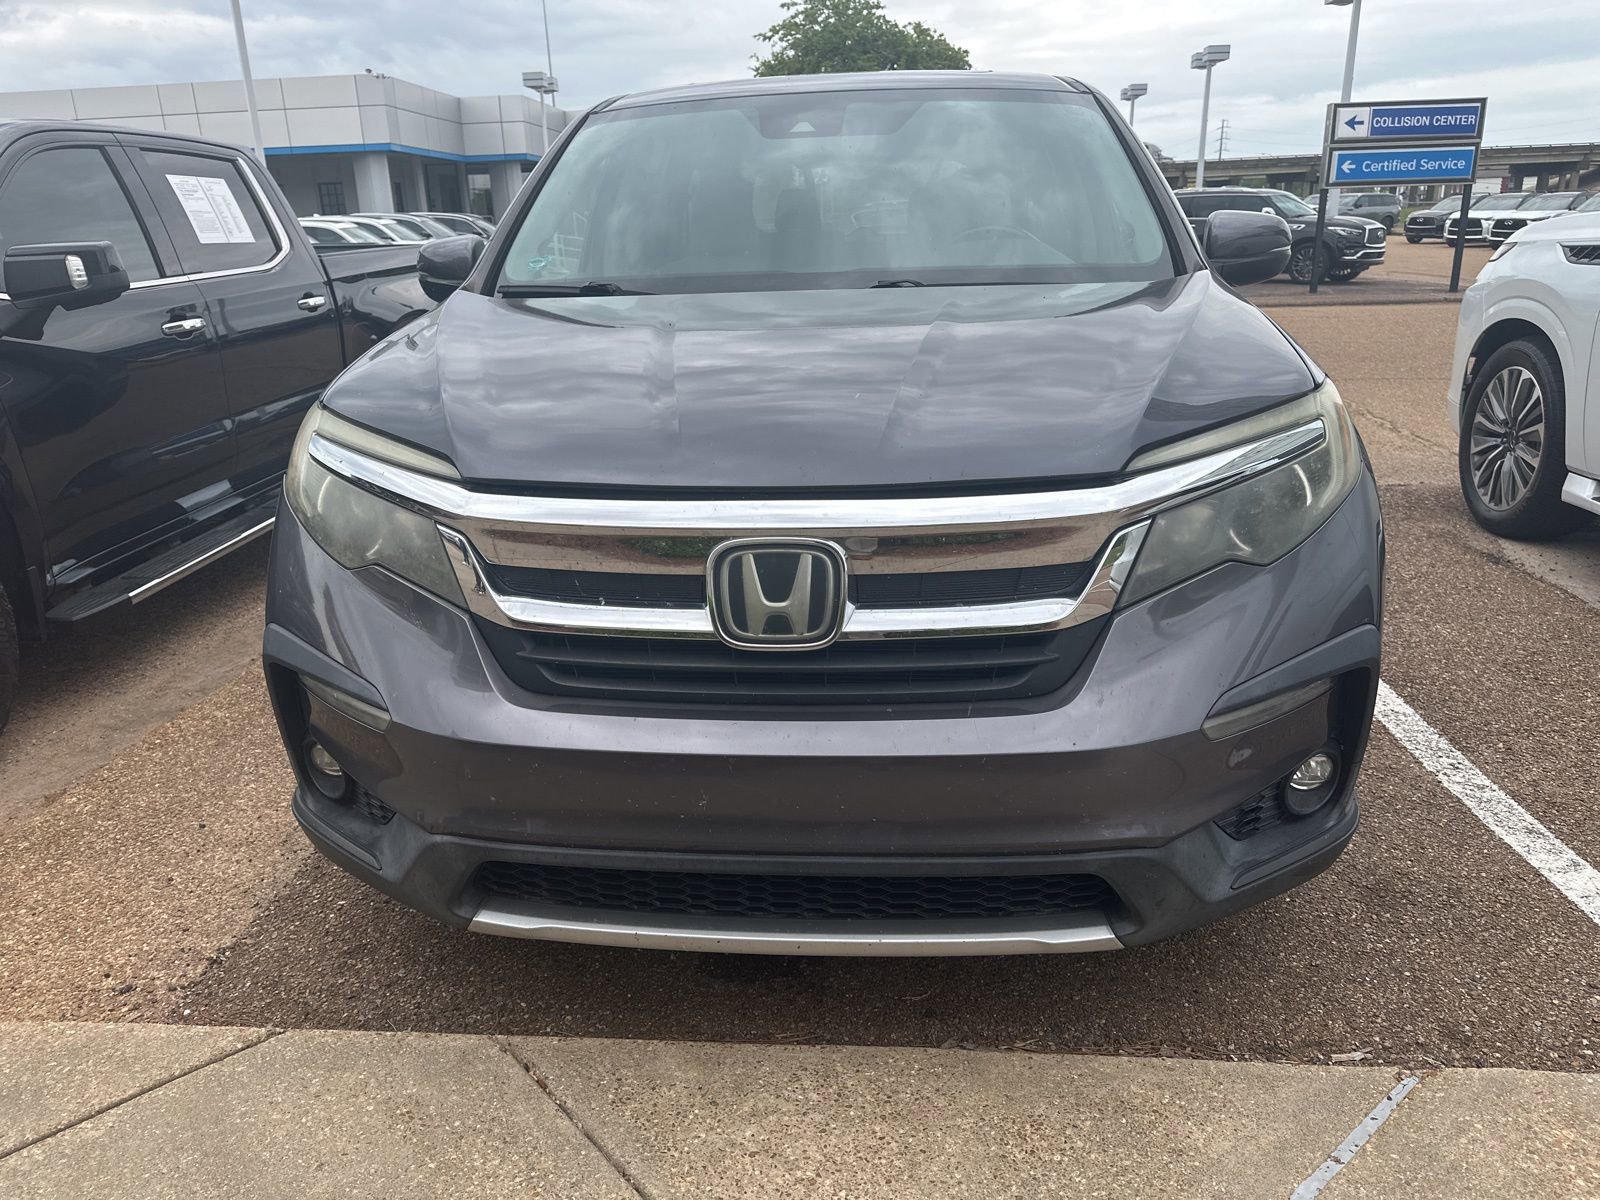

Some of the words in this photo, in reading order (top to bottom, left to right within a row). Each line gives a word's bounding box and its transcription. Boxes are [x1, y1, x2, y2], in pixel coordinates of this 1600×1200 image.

[1373, 115, 1430, 128] COLLISION
[1433, 114, 1475, 126] CENTER
[1362, 159, 1416, 172] Certified
[1420, 158, 1465, 171] Service
